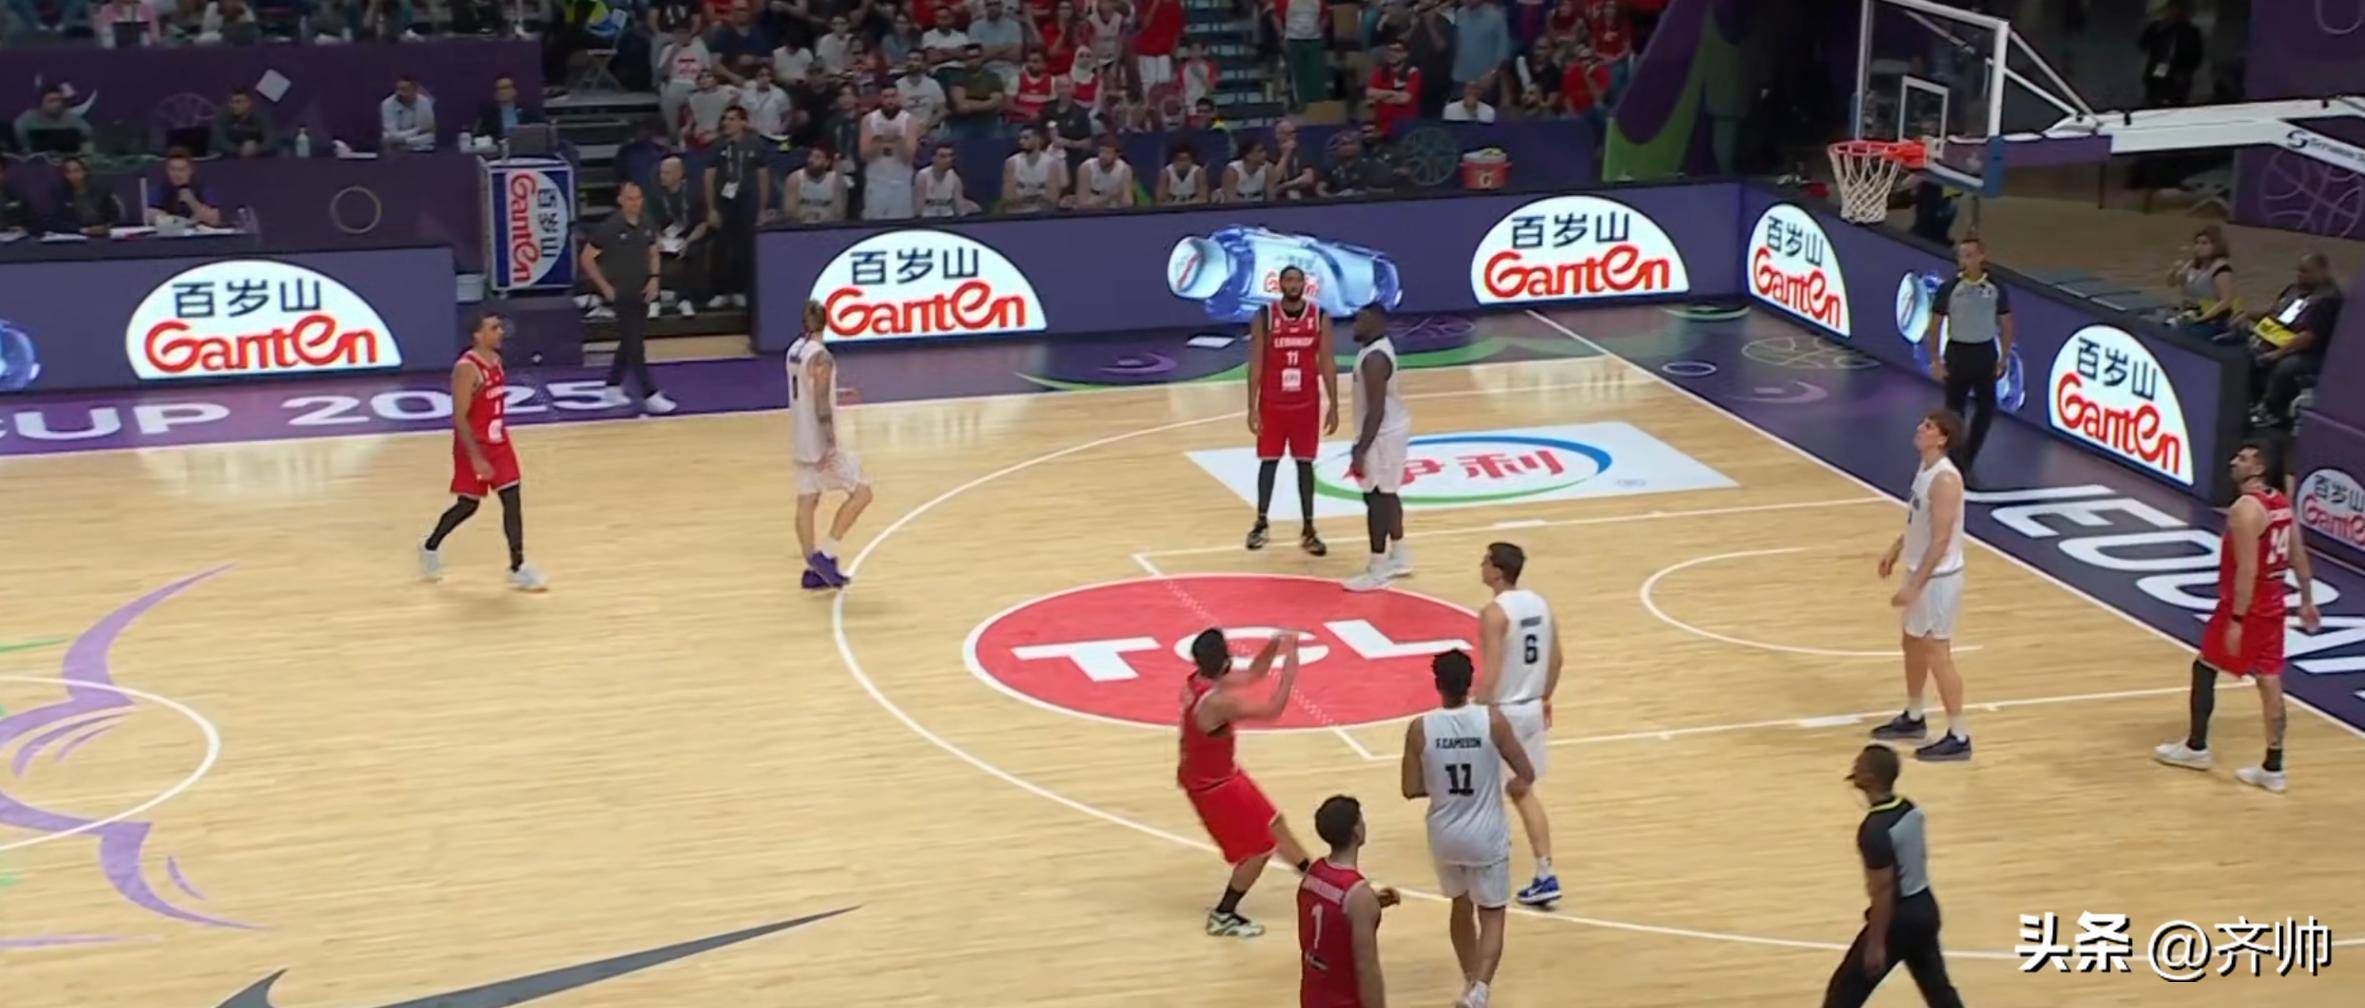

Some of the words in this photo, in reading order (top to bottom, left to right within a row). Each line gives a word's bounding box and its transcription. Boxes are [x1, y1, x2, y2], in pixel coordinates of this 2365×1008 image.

[1511, 210, 1630, 250] 百岁山
[1767, 215, 1824, 268] 百岁山
[850, 246, 979, 286] 百岁山
[172, 277, 322, 318] 百岁山
[2077, 336, 2157, 402] 百岁山
[0, 396, 230, 440] UP
[1011, 618, 1473, 682] TCL
[1524, 634, 1538, 665] 6
[1445, 763, 1475, 796] 11
[1312, 904, 1323, 949] 1
